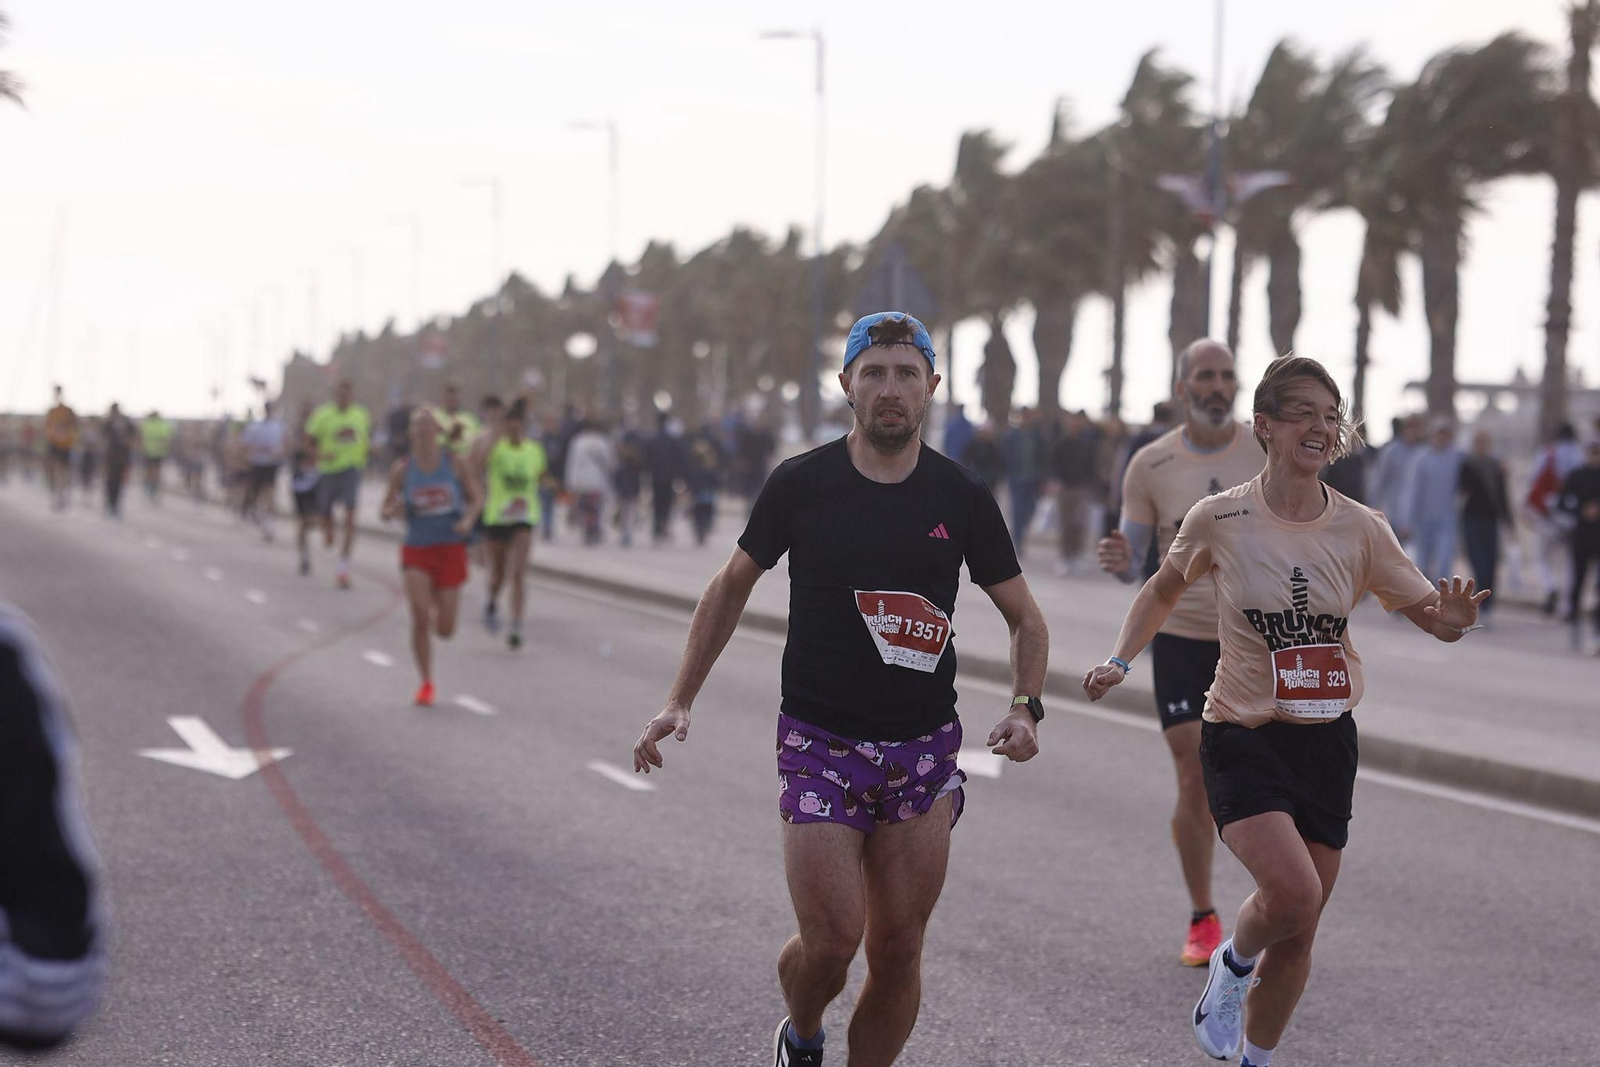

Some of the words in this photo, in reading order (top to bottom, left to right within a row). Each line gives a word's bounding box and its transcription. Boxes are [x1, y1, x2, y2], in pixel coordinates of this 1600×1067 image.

[1214, 510, 1240, 521] luanvi
[904, 618, 944, 643] 1351
[1243, 608, 1348, 639] BRUNCH
[1279, 668, 1320, 680] BRUNCH
[1327, 670, 1346, 688] 329
[1284, 678, 1304, 690] RUN
